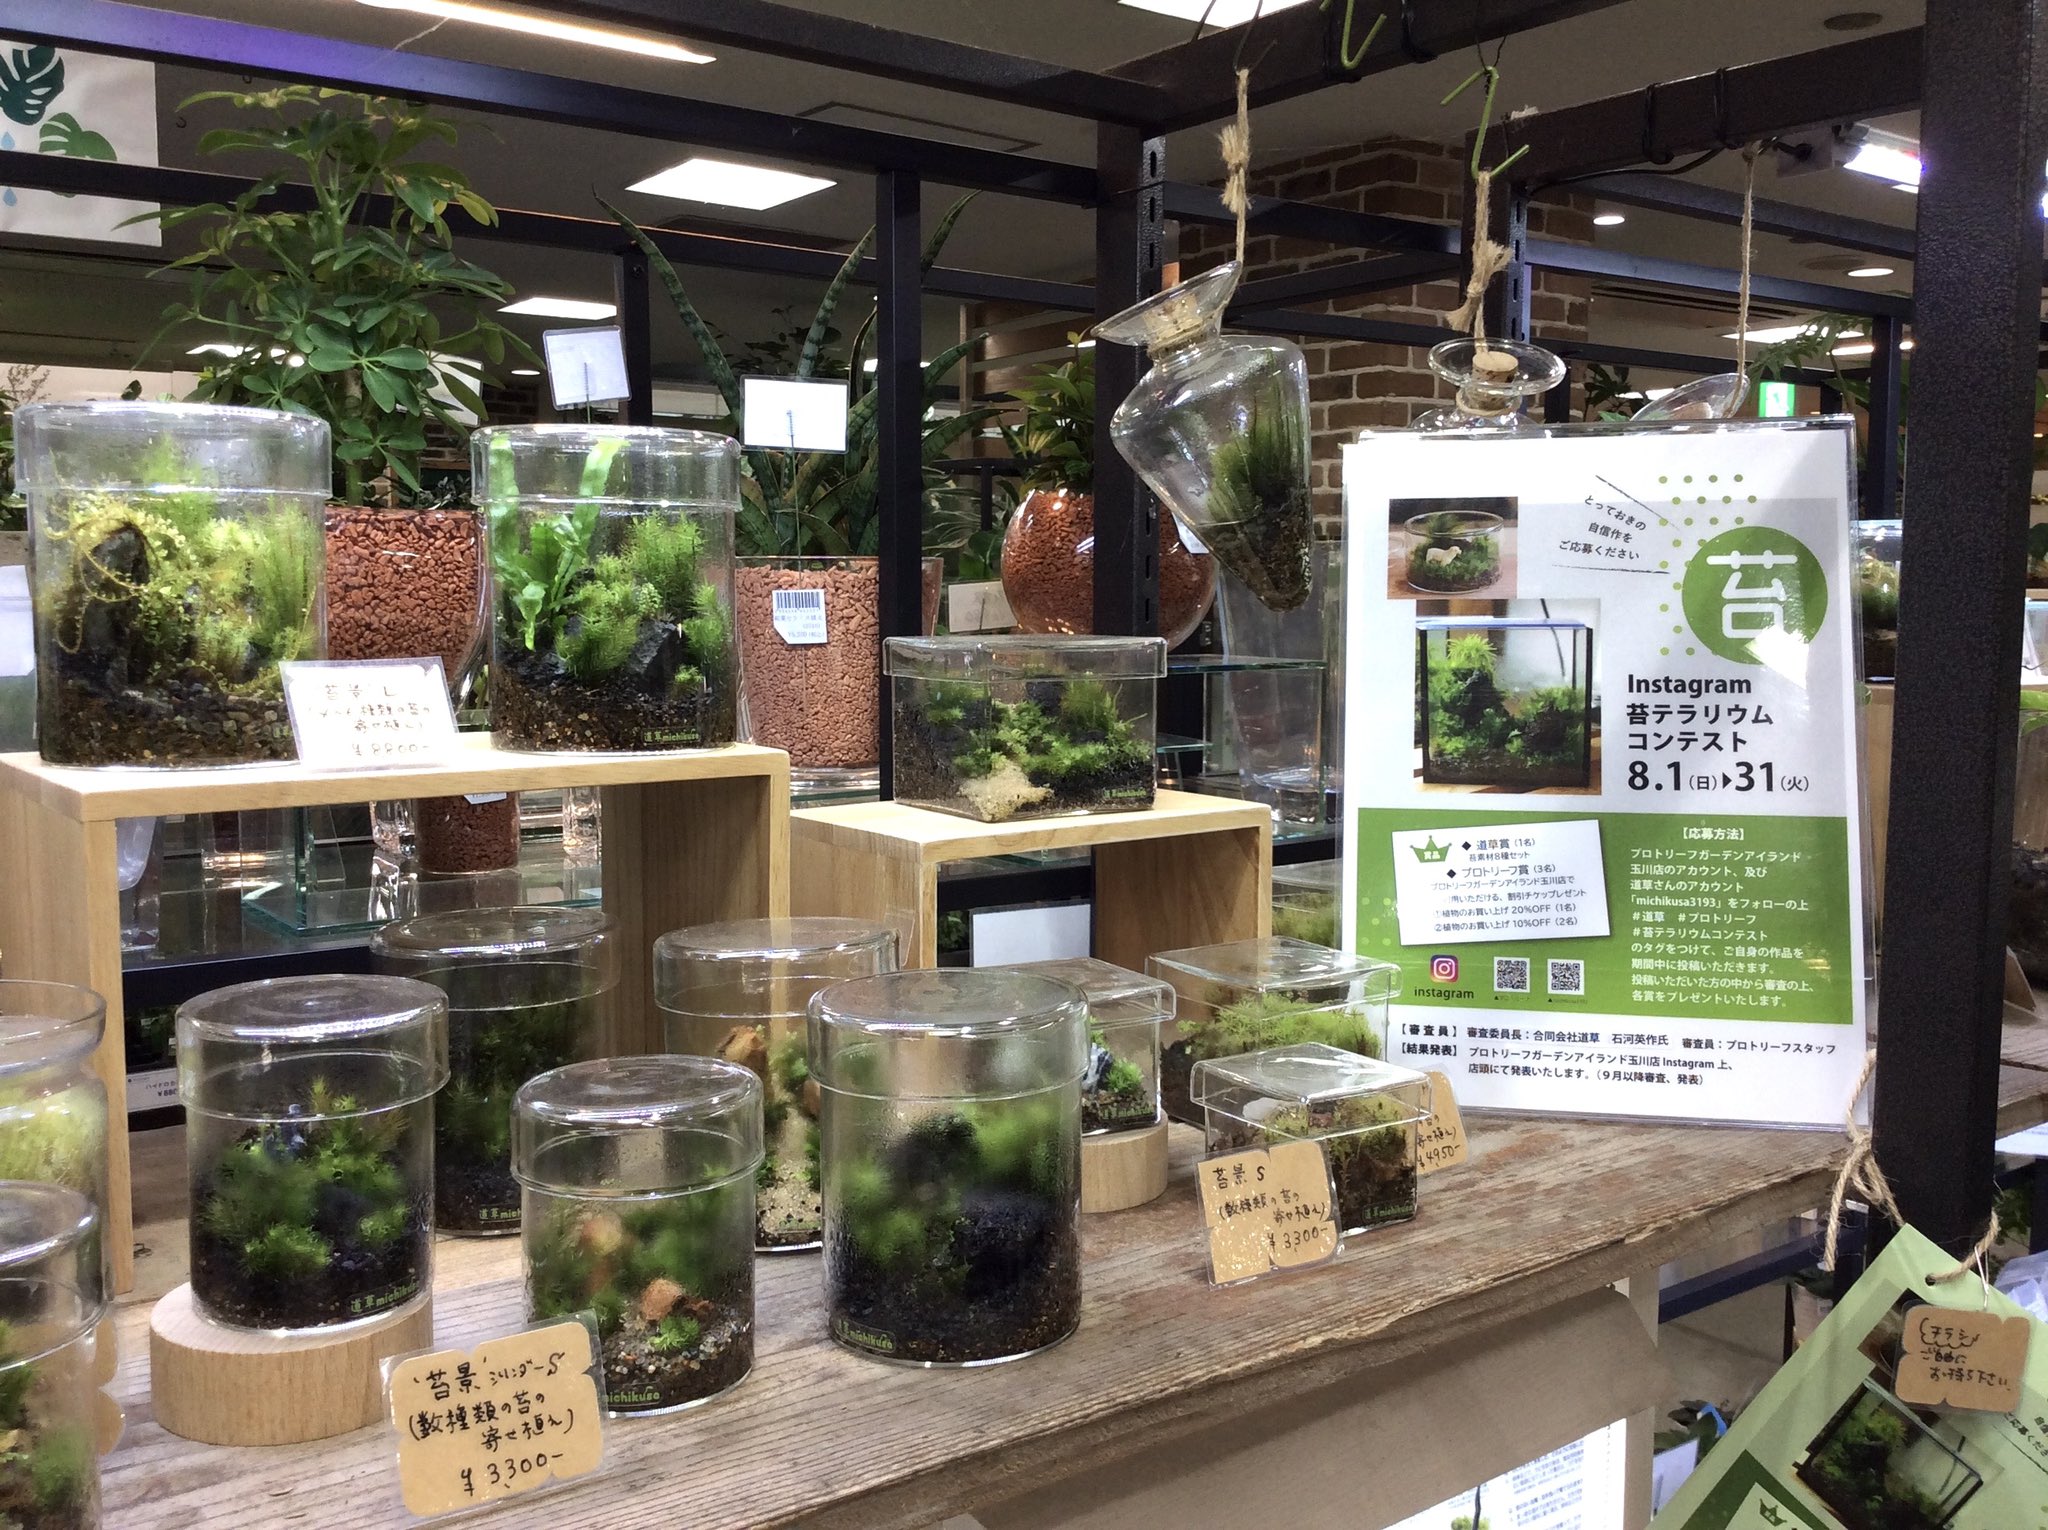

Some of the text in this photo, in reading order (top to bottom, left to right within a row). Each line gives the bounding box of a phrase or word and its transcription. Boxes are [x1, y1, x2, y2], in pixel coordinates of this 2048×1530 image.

[1584, 495, 1647, 532] とっておきの
[1588, 522, 1633, 543] 自信作を
[1559, 540, 1640, 560] ご応募ください
[1706, 549, 1798, 639] 苔
[1628, 674, 1751, 698] Instagram
[1627, 703, 1773, 725] 苔テラリウム
[1628, 731, 1747, 752] コンテスト
[1683, 827, 1745, 841] 【応募方法】
[1630, 848, 1801, 863] プロトリーフガーデンアイランド
[1630, 864, 1768, 878] 玉川店のアカウント、及び
[1630, 879, 1744, 893] 道草さんのアカウント
[1631, 943, 1803, 959] のタグをつけて、ご自身の作品を
[1631, 958, 1775, 974] 期間中に投稿いただきます。
[1631, 974, 1814, 992] 投稿いただいた方の中から審査の上、
[1414, 988, 1474, 1001] instagram
[1631, 990, 1786, 1007] 各賞をプレゼントいたします。
[1612, 1034, 1669, 1046] 石河英作氏
[1682, 1038, 1836, 1054] 審査員：プロトリーフスタッフ
[1401, 1043, 1457, 1057] 【結果発表】
[1663, 1058, 1714, 1070] Instagram
[1931, 1326, 1969, 1341] チラシ
